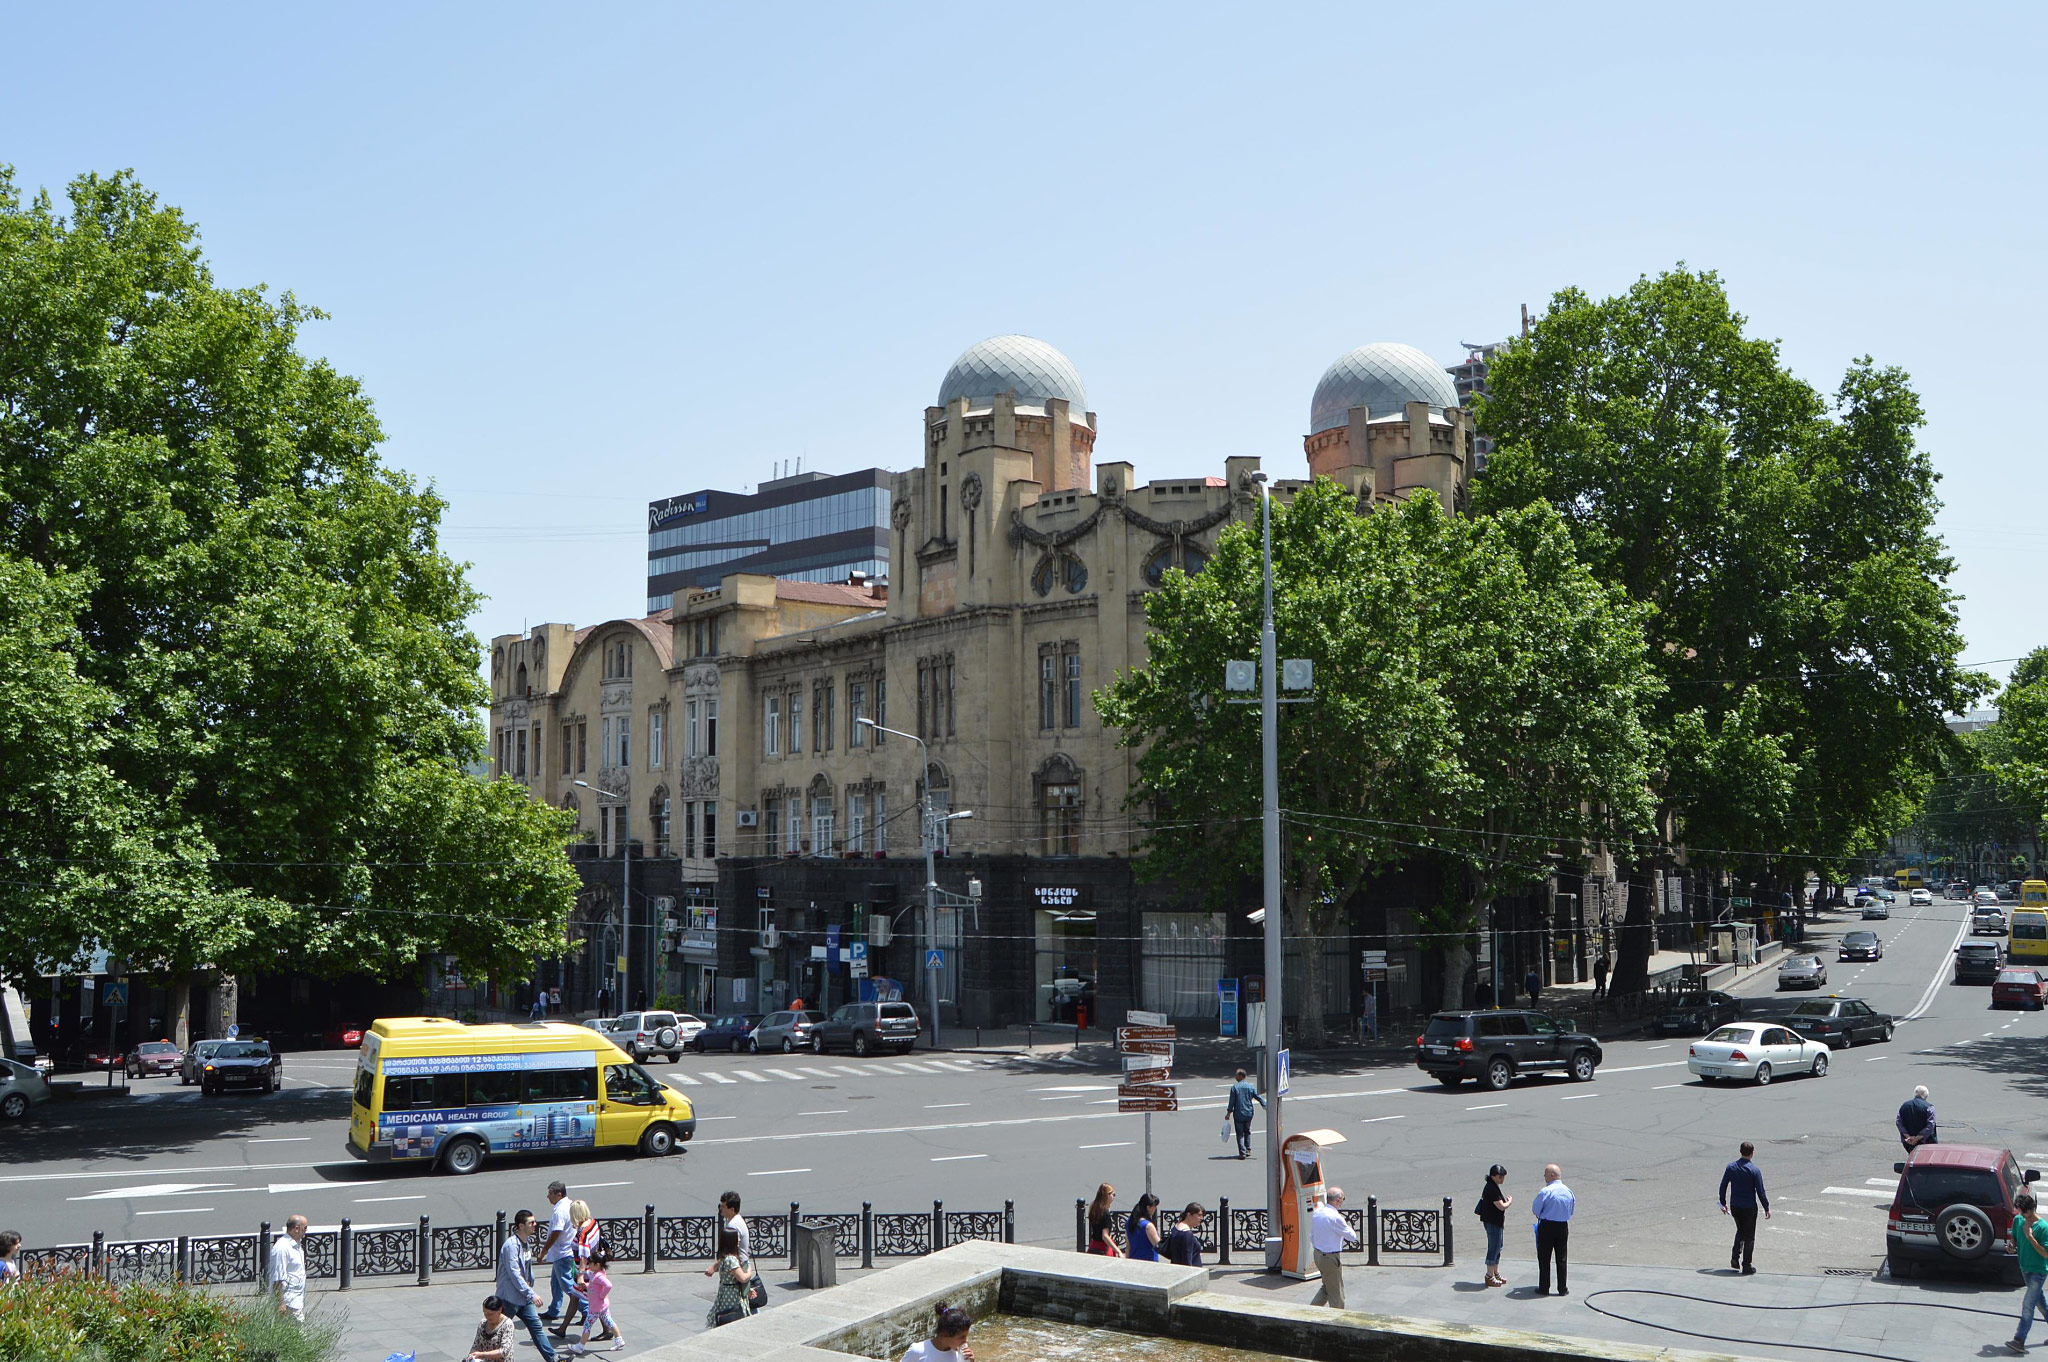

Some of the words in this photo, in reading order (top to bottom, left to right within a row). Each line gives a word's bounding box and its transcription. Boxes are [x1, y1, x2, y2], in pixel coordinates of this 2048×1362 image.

[648, 499, 694, 530] Radisson
[1041, 896, 1073, 905] სახლი
[853, 943, 864, 957] P
[386, 1112, 443, 1125] MEDICANA
[448, 1112, 479, 1121] HEALTH
[481, 1111, 509, 1120] GROUP
